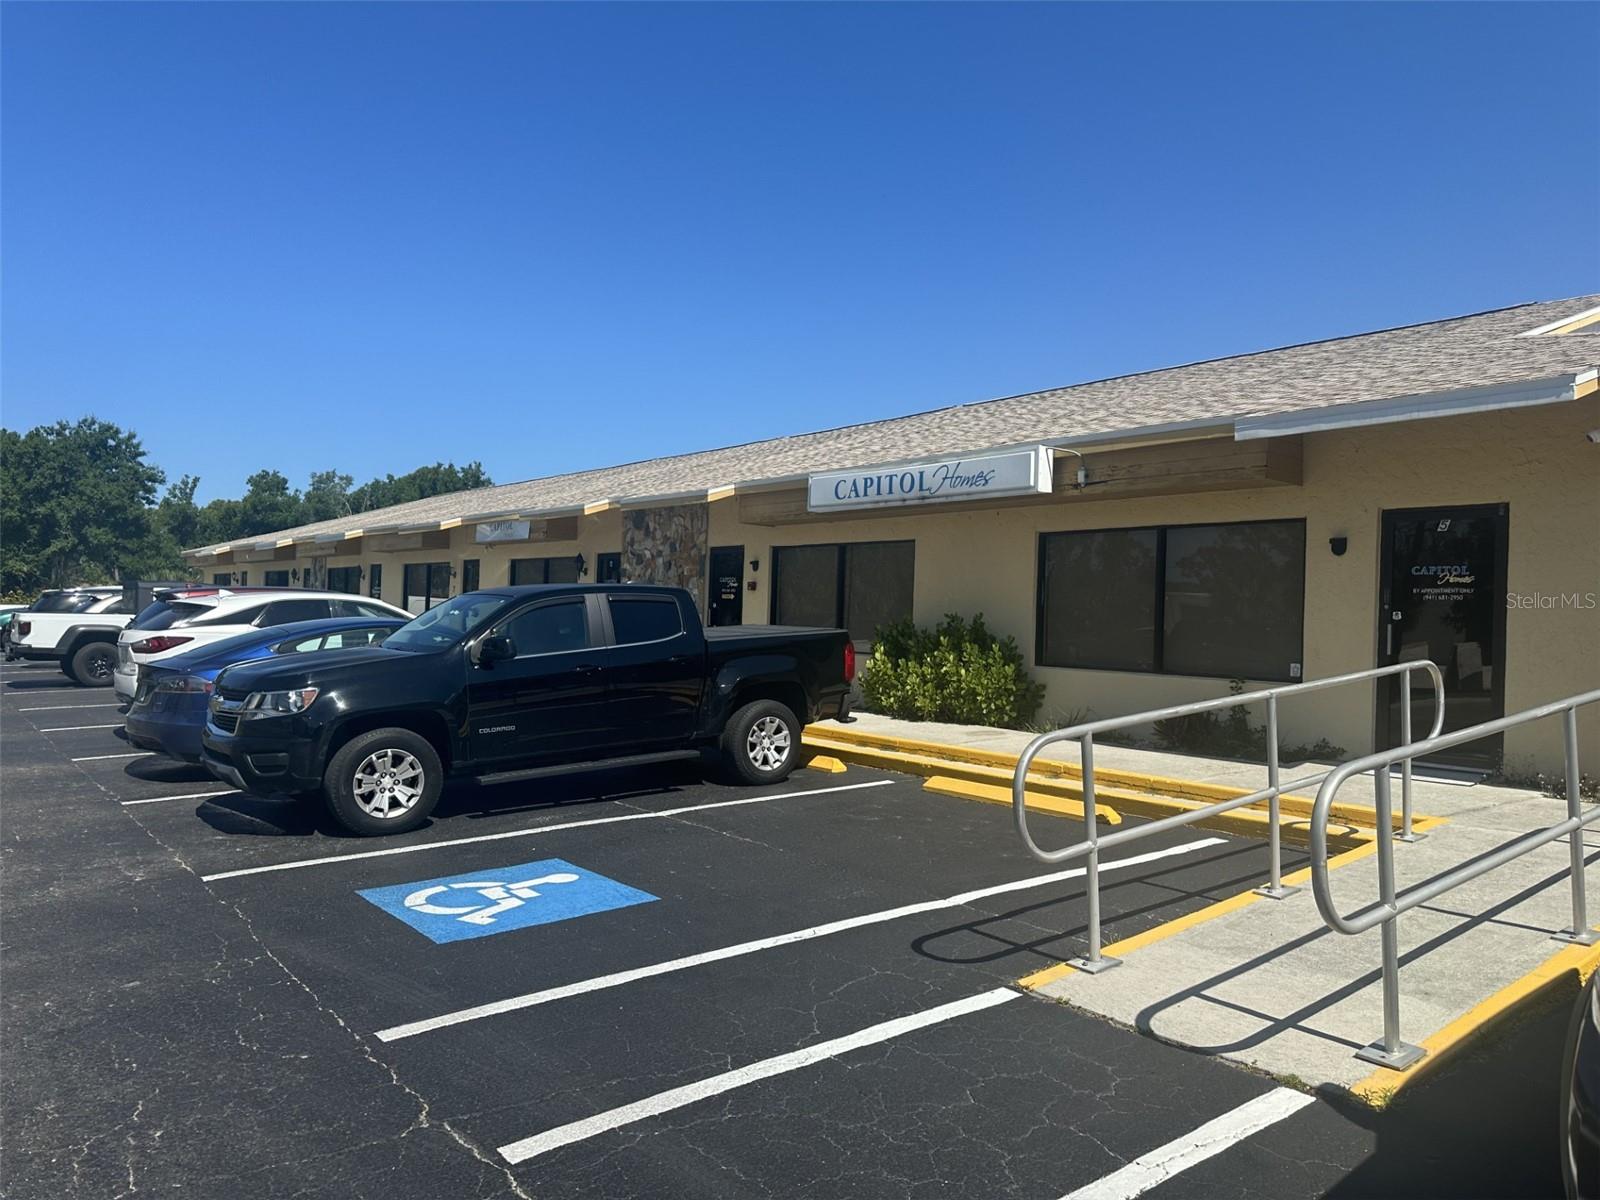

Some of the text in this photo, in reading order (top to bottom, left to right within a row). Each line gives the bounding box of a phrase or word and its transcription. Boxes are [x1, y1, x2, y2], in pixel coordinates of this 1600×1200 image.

[834, 461, 996, 500] CAPITOL Homes
[1411, 565, 1470, 575] CAPITOL
[478, 725, 516, 734] COLORADO
